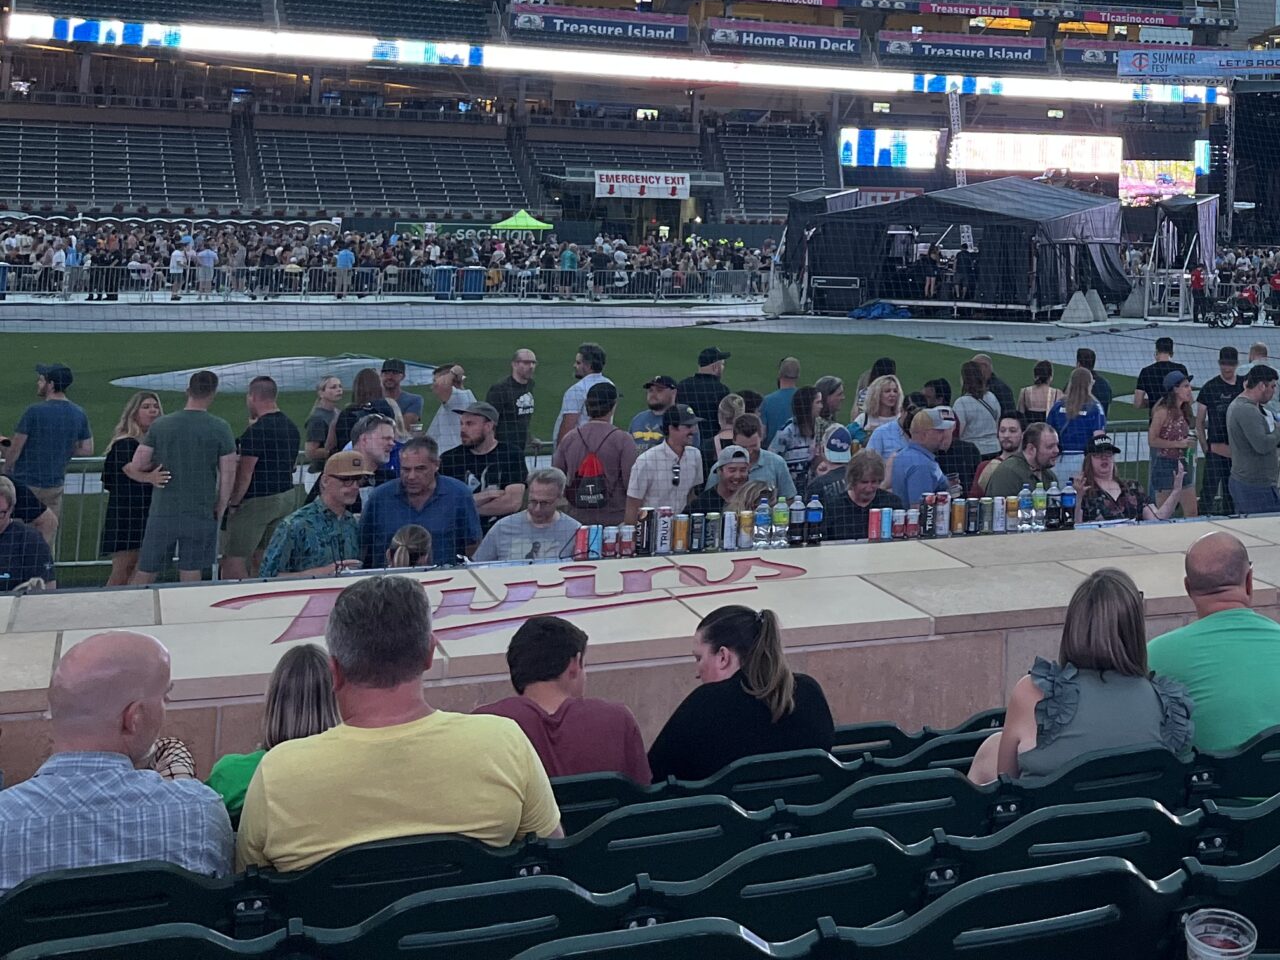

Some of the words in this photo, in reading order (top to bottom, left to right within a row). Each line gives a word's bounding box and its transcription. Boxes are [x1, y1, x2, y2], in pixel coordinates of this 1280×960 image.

[930, 4, 976, 16] Treasure
[978, 6, 1009, 17] Island
[553, 19, 623, 37] Treasure
[627, 24, 675, 40] Island
[742, 33, 785, 48] Home
[788, 36, 817, 50] Run
[819, 39, 855, 53] Deck
[922, 45, 986, 59] Treasure
[989, 47, 1032, 60] Island
[1152, 52, 1196, 65] SUMMER
[1151, 64, 1168, 73] FEST
[1219, 59, 1254, 67] LET'S
[599, 174, 661, 185] EMERGENCY
[664, 176, 686, 186] EXIT
[925, 504, 934, 531] TRULY
[660, 519, 669, 548] TRULY
